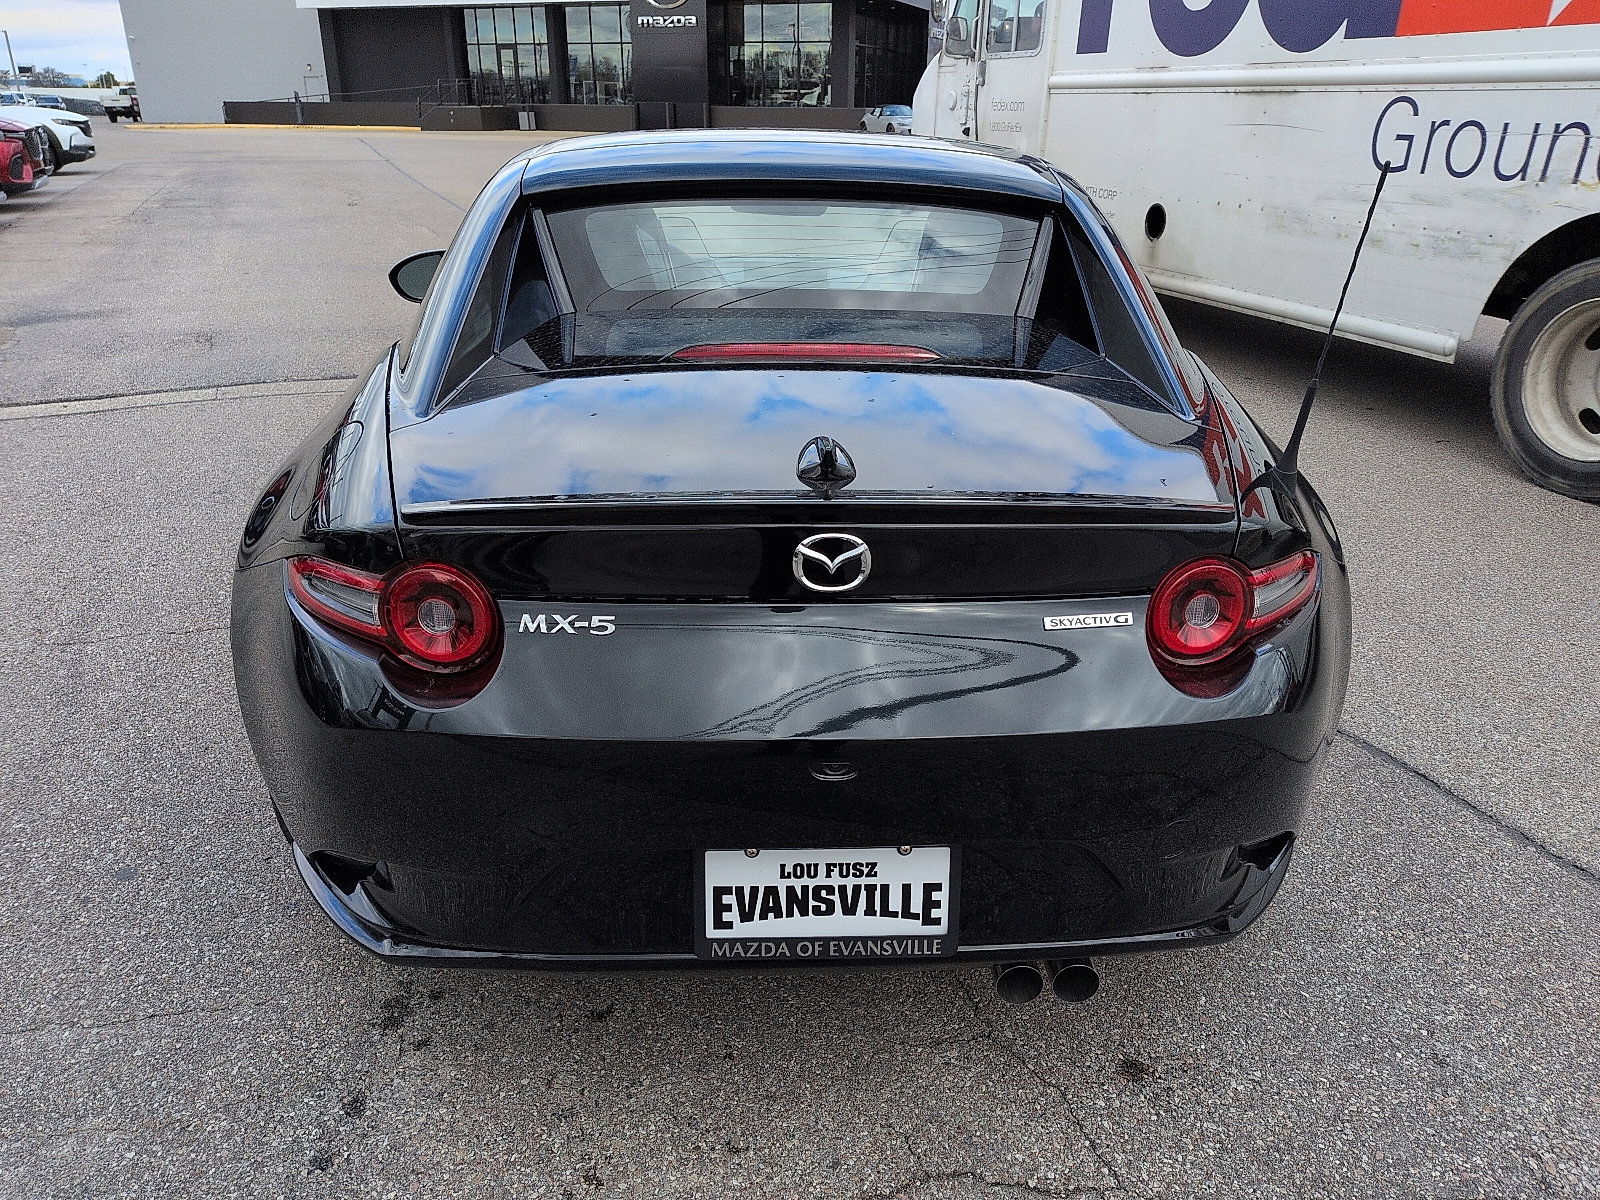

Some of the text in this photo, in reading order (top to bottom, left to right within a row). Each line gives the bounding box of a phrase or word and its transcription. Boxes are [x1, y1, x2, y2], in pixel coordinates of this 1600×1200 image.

[1371, 95, 1600, 184] Groun
[1098, 188, 1118, 200] CORP
[518, 613, 616, 636] MX-5
[779, 861, 878, 880] LOU FUSZ
[712, 882, 943, 931] EVANSVILLE
[711, 939, 942, 958] MAZDA OF EVANSVILLE
